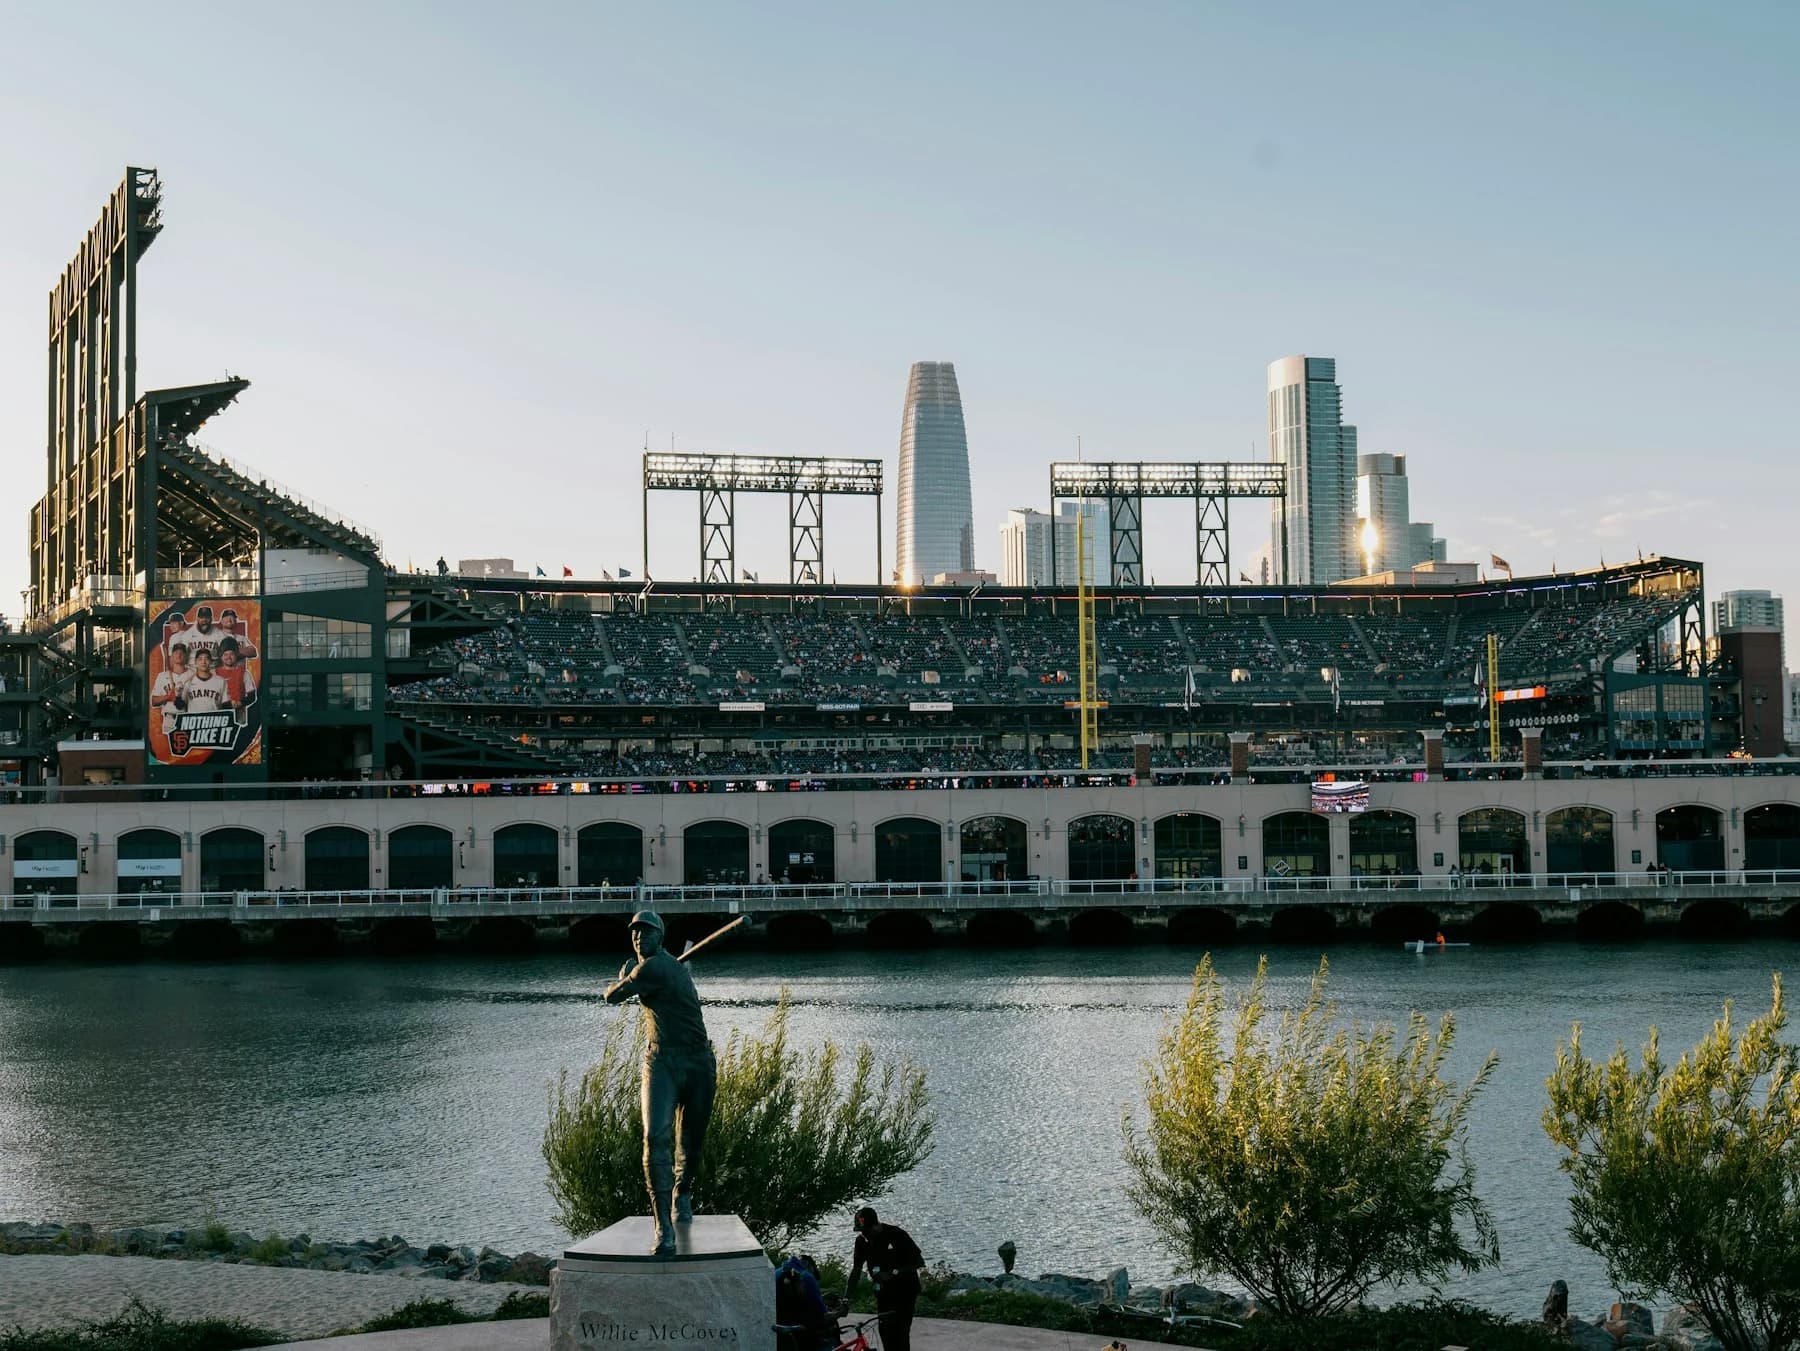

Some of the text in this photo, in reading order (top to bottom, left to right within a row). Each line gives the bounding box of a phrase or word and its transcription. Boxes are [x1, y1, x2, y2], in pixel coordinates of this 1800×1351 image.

[188, 687, 220, 700] GIANTS
[180, 715, 230, 731] NOTHING
[188, 727, 234, 744] LIKE IT
[580, 1322, 738, 1342] Willie McCovey
